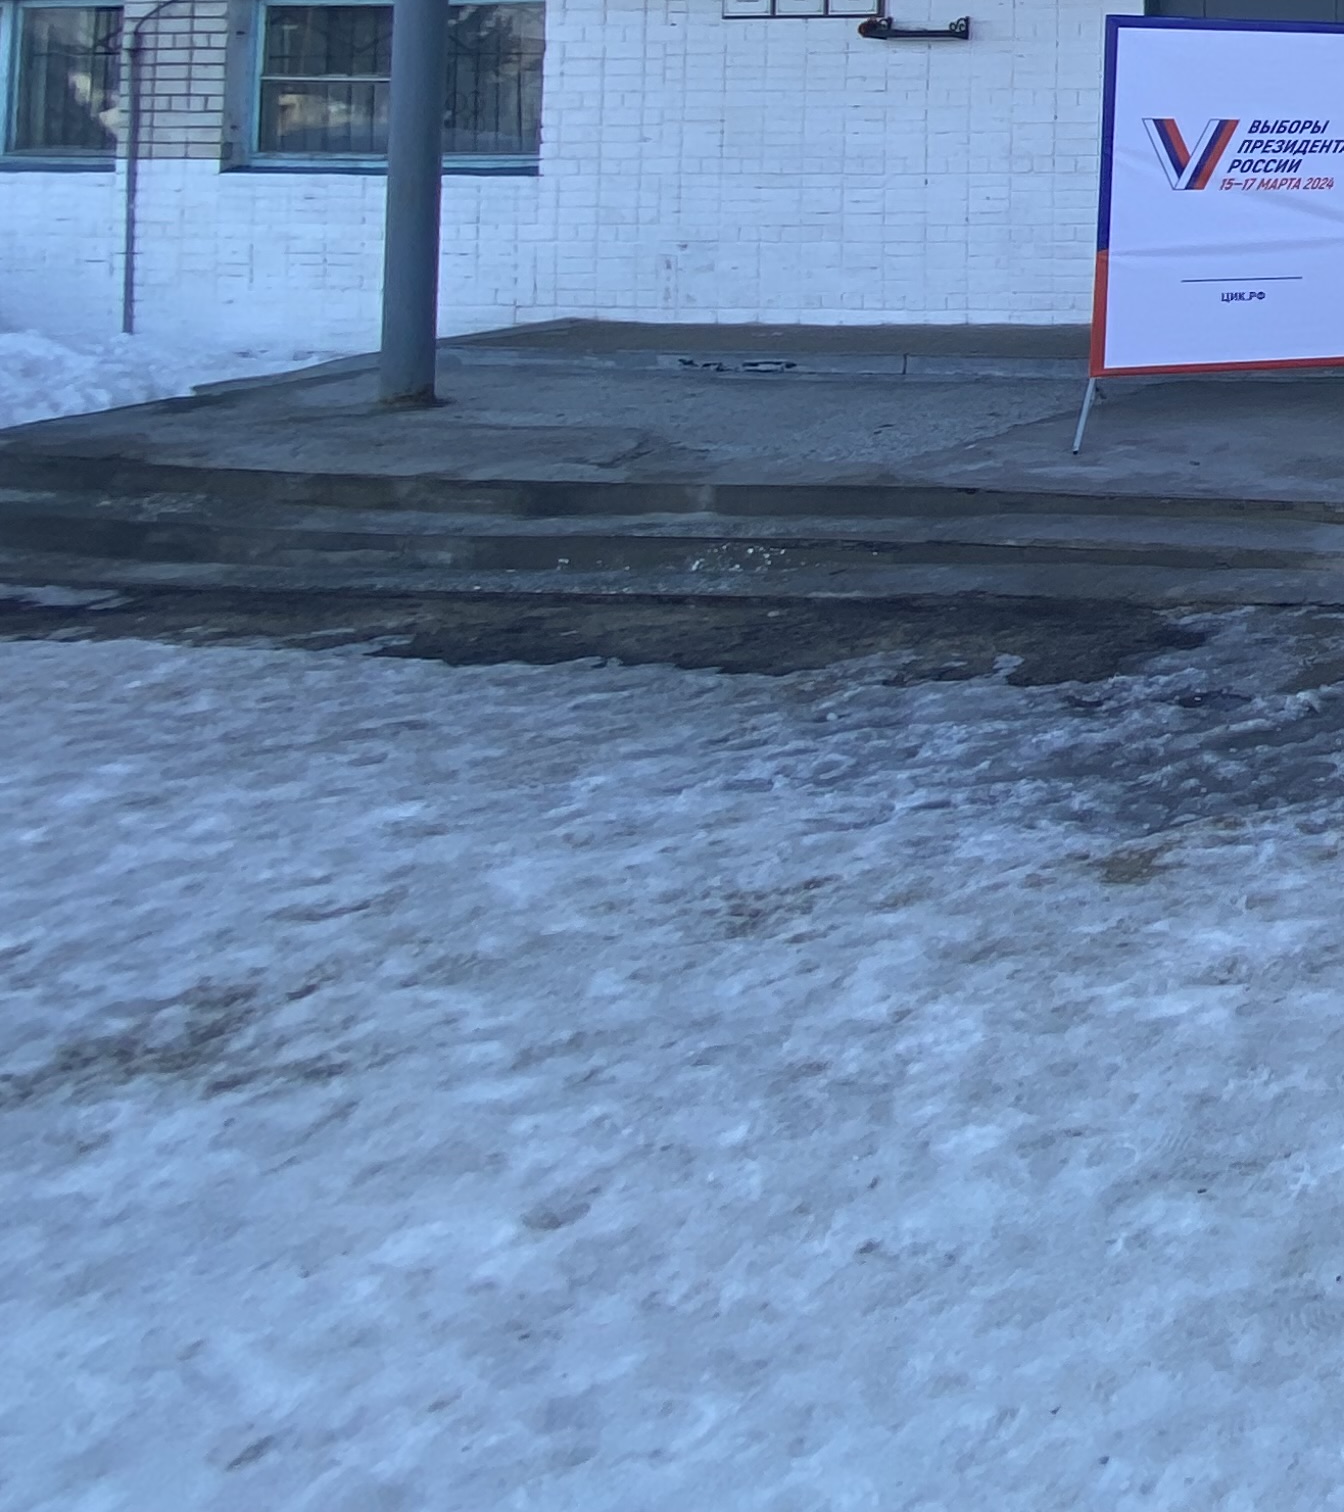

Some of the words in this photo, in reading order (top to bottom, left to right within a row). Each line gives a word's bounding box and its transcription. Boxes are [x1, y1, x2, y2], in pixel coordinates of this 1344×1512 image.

[1247, 119, 1330, 135] ВЫБОРЫ
[1226, 158, 1303, 174] РОССИИ
[1256, 177, 1302, 190] МАРТА
[1302, 176, 1335, 190] 2024
[1220, 291, 1266, 303] ЦИК.РФ
